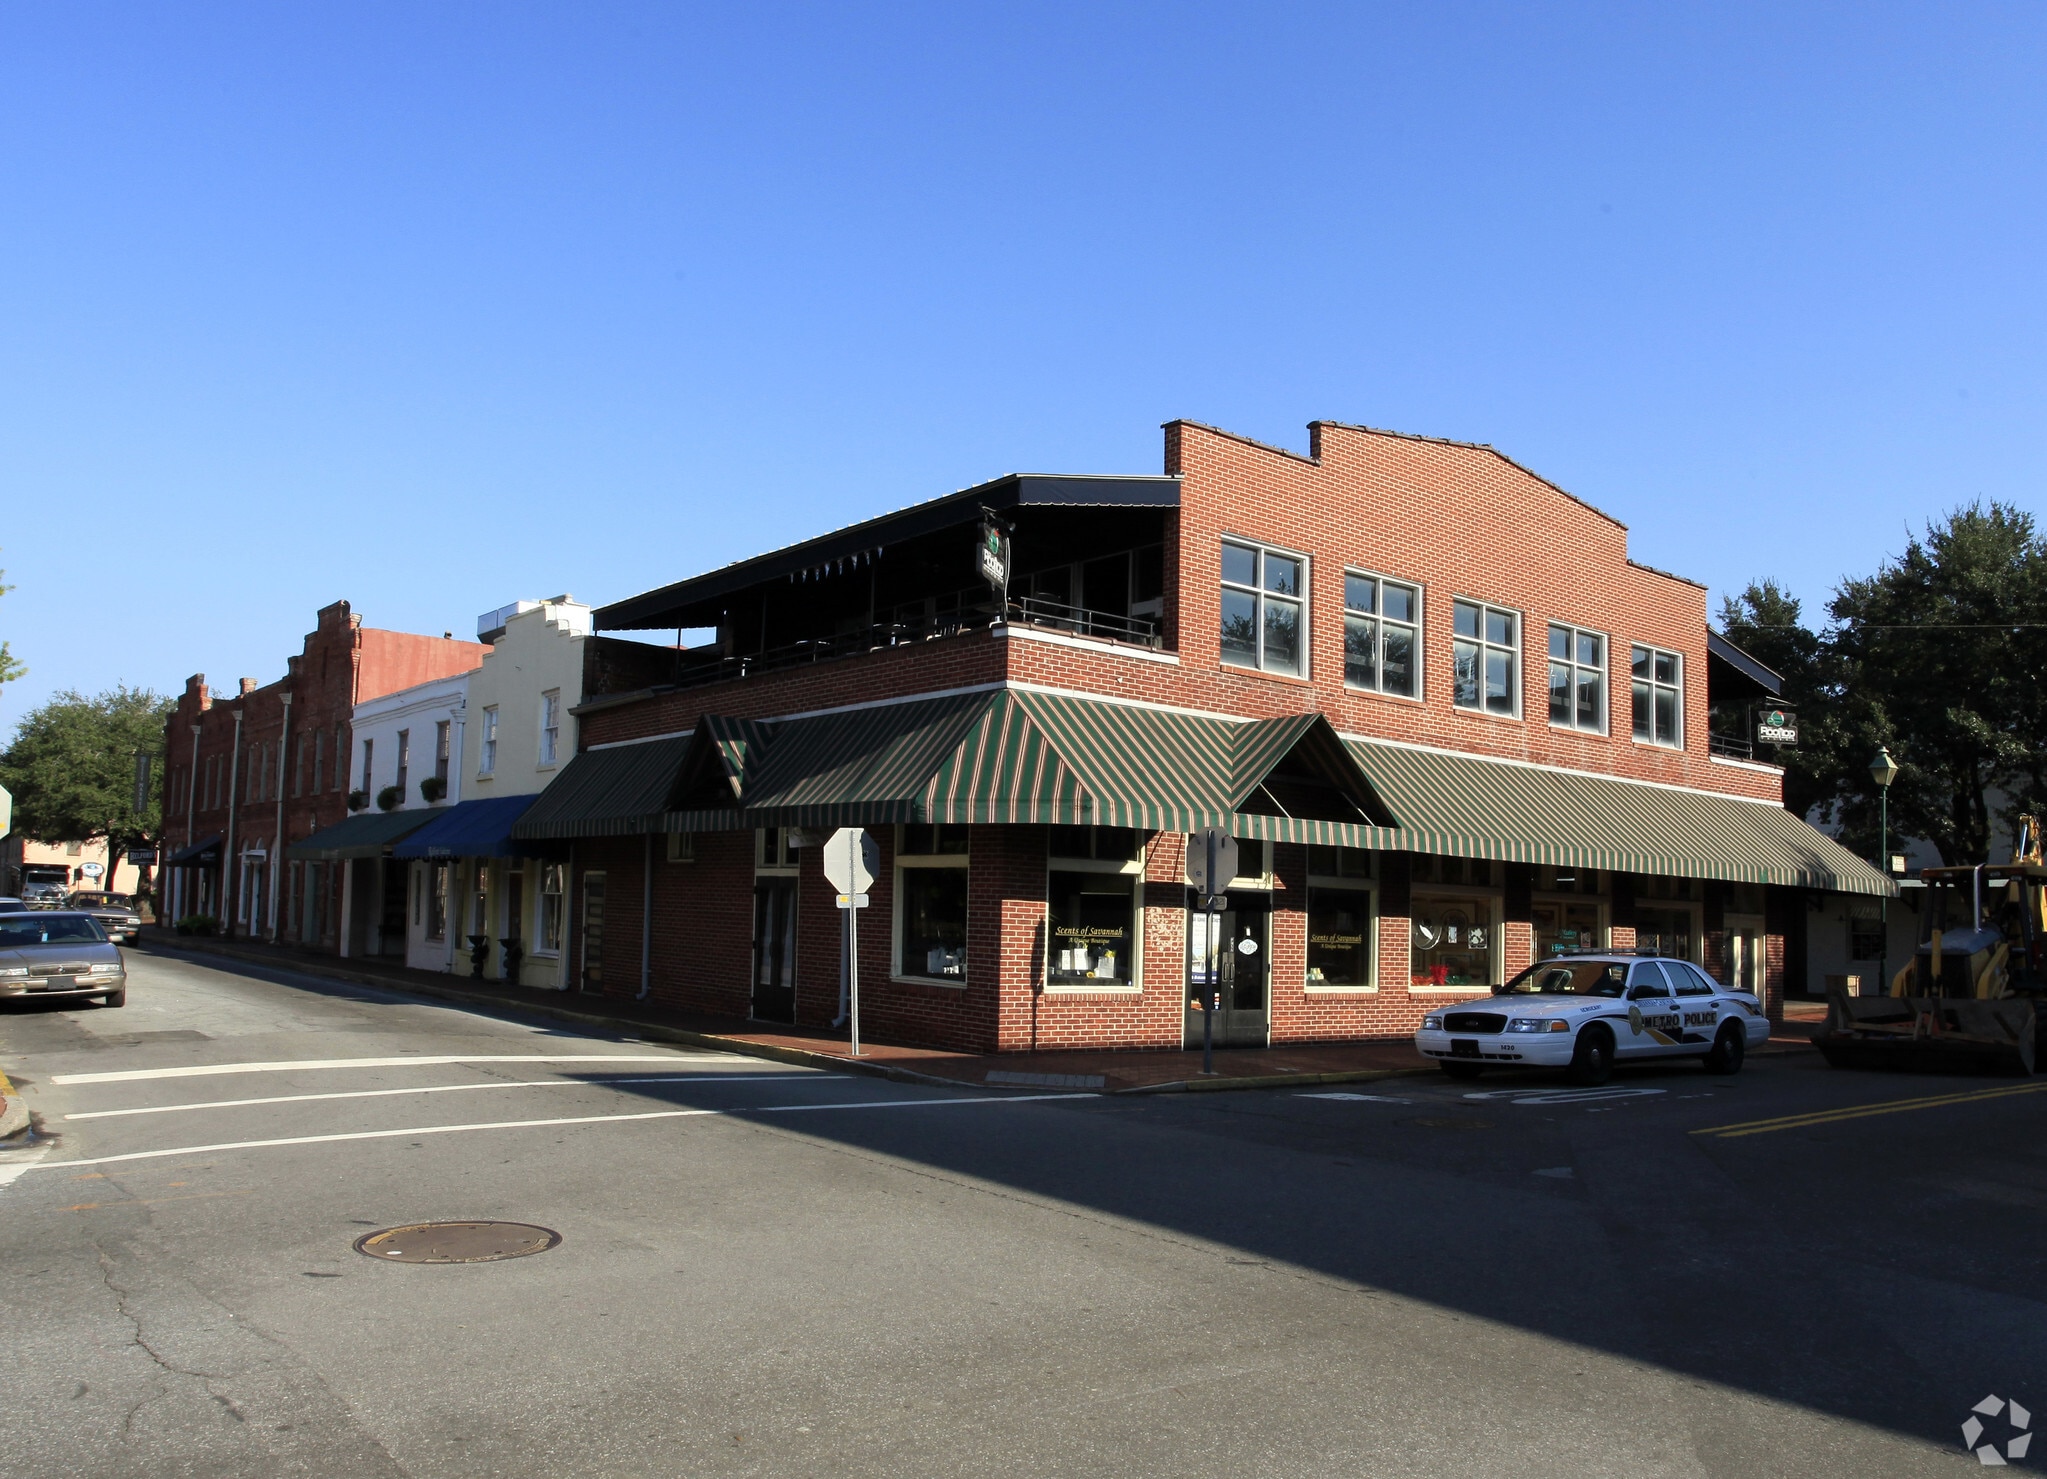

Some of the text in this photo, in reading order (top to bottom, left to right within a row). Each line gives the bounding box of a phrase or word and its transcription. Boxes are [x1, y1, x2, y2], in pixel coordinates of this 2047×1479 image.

[1056, 925, 1123, 938] Scents of Savannah
[1311, 933, 1329, 941] Scents
[1337, 933, 1362, 942] Savannah
[1643, 1011, 1717, 1029] METRO POLICE
